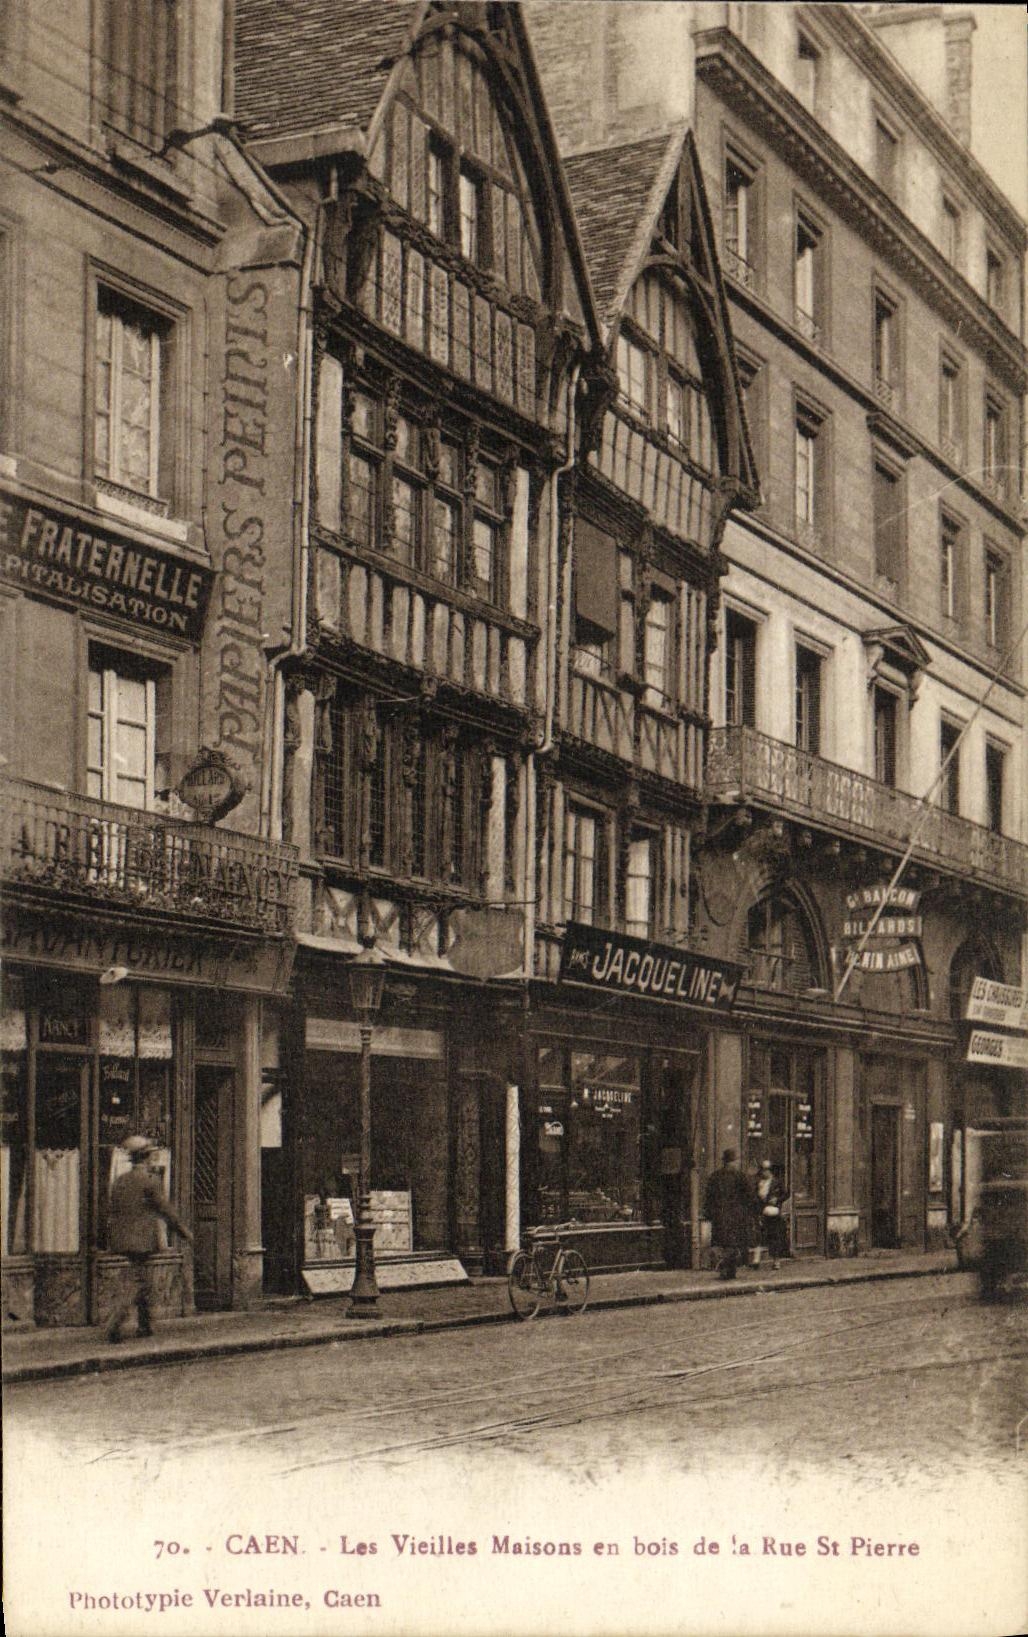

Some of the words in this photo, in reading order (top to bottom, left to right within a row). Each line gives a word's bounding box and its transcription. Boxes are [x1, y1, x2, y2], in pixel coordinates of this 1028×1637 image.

[217, 273, 269, 497] PEINTS
[21, 507, 203, 609] FRATERNELLE
[212, 501, 266, 755] PAPIERS
[592, 943, 722, 1004] JACQUELINE
